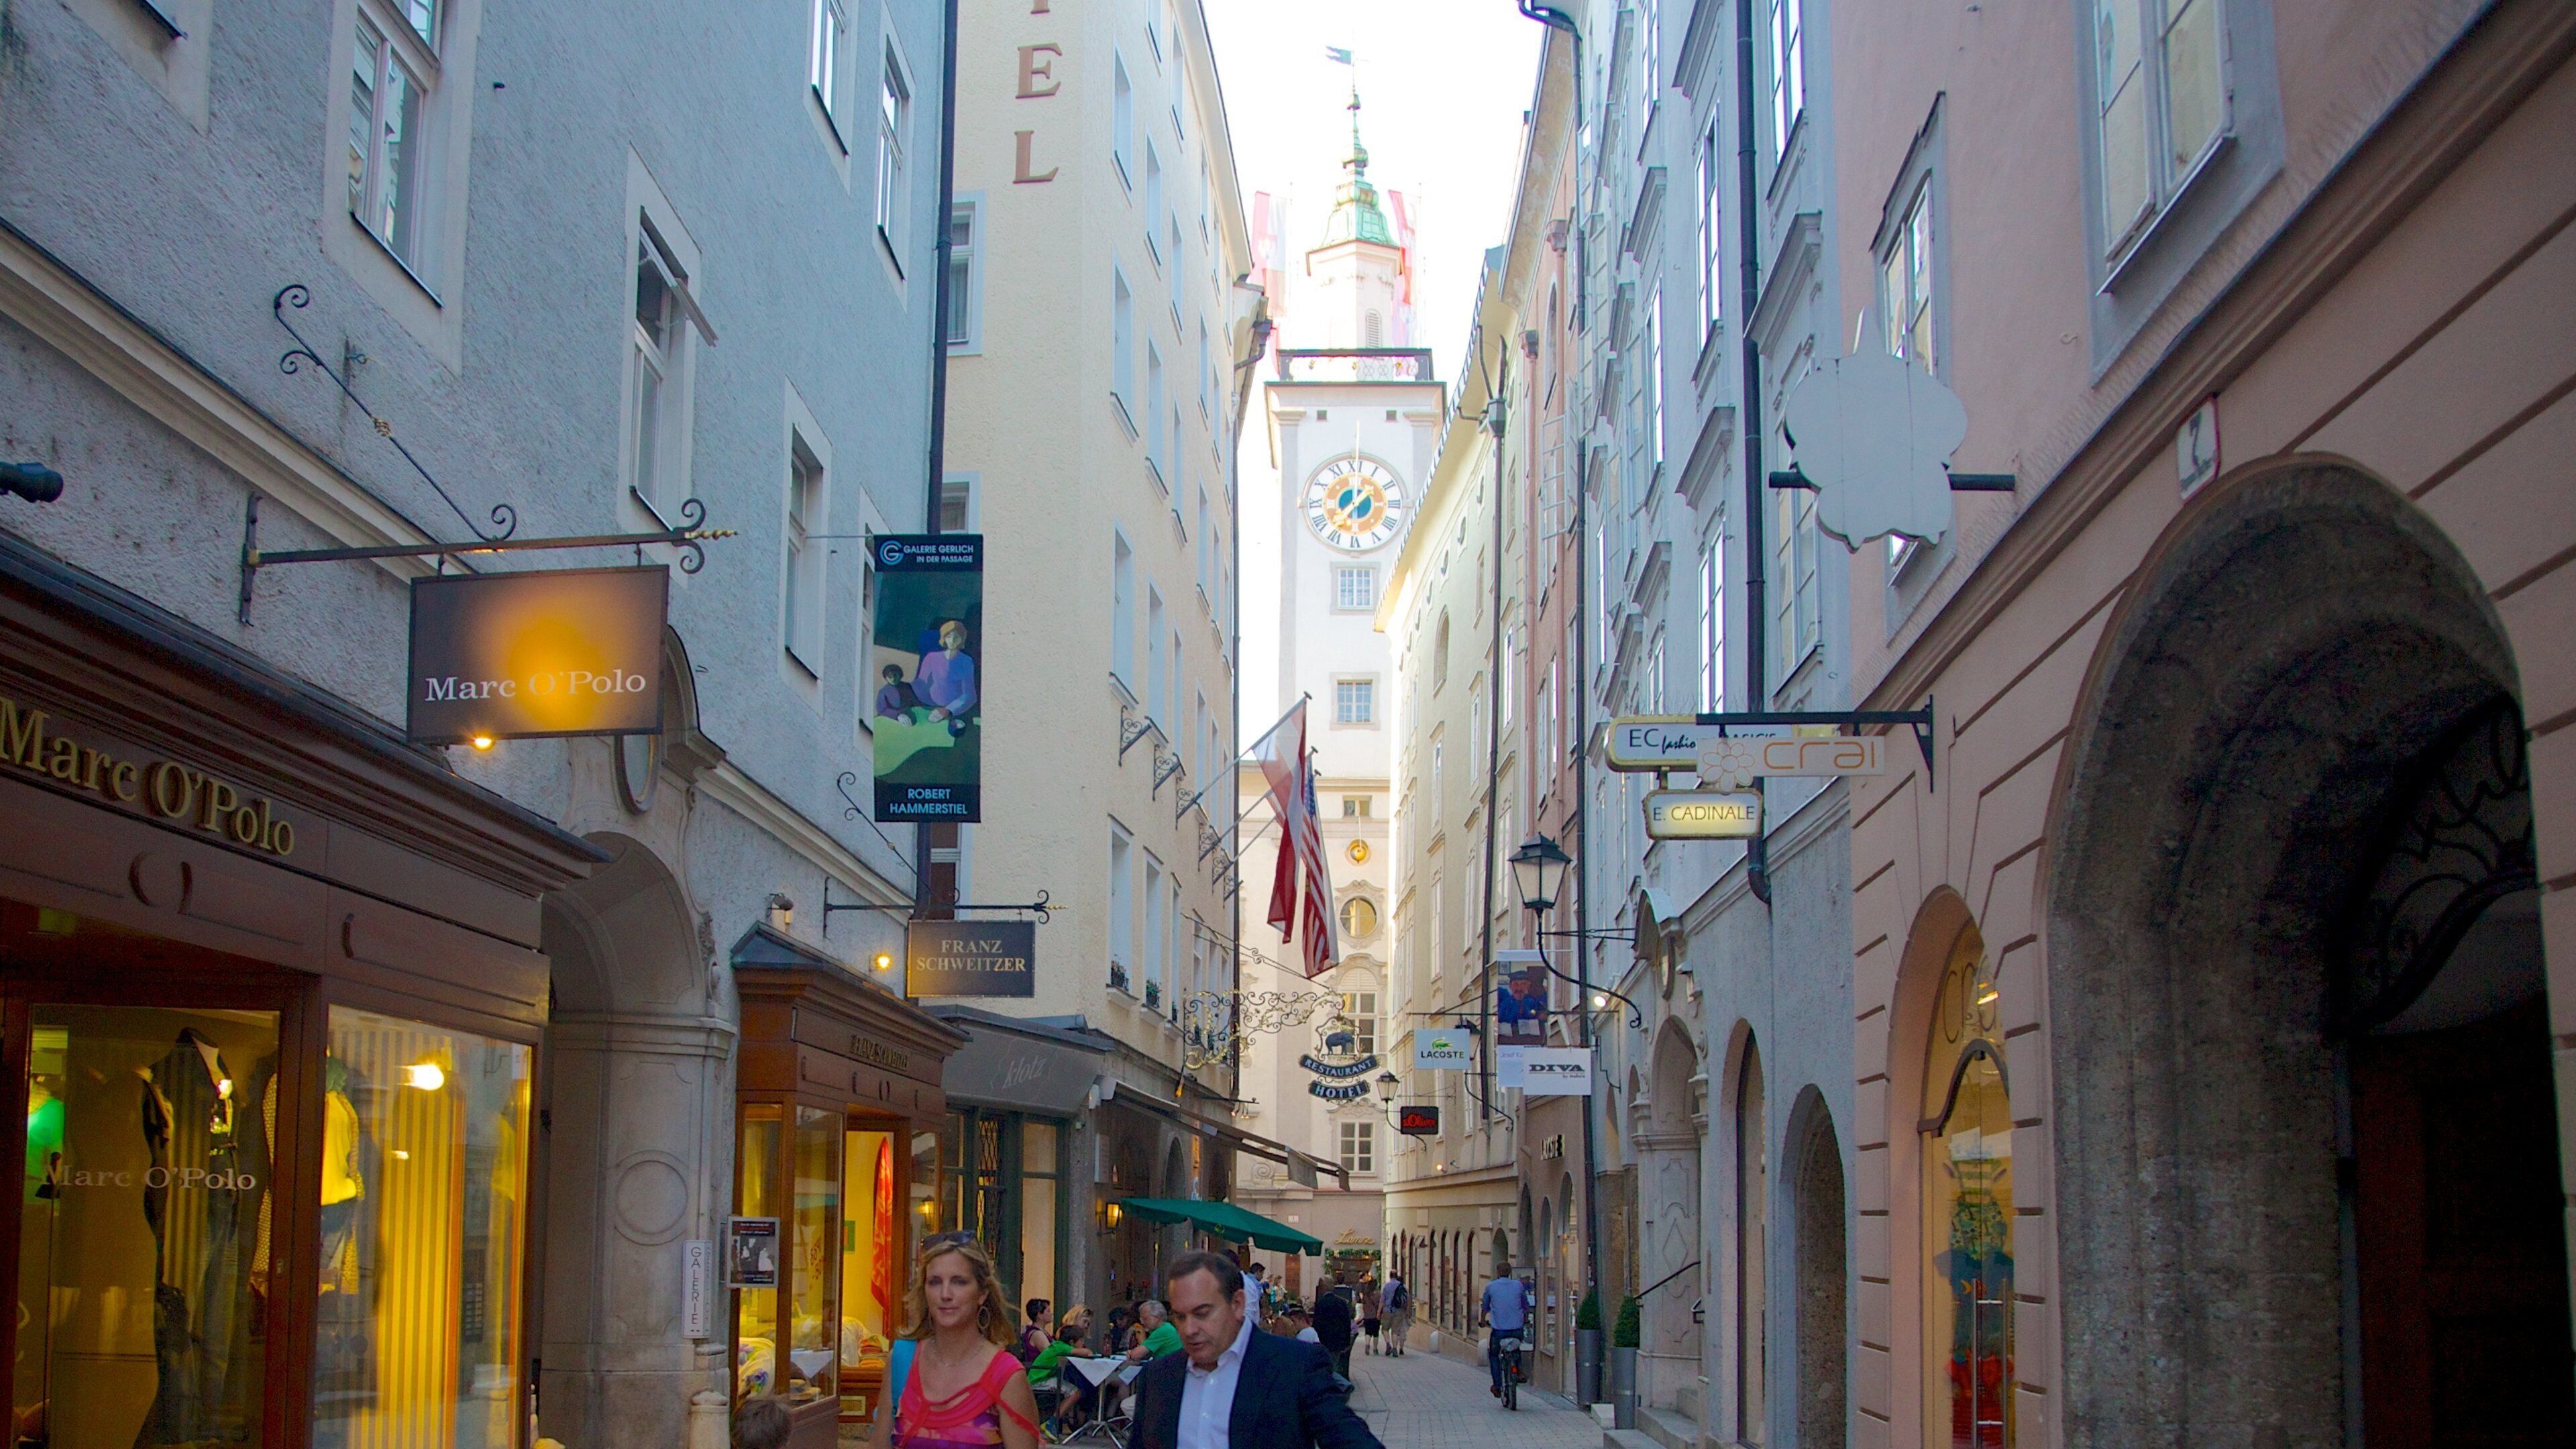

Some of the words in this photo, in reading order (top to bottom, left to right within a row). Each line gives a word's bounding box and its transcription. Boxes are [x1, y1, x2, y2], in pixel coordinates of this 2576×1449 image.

[1012, 0, 1062, 184] EL
[903, 545, 936, 553] GALERIE
[938, 545, 973, 553] GERLICH
[425, 676, 516, 701] Marc
[529, 669, 646, 696] O'Polo
[1662, 734, 1697, 755] fashio
[0, 696, 138, 802] Marc
[155, 760, 295, 856] O'Polo
[908, 788, 951, 799] ROBERT
[890, 803, 968, 814] HAMMERSTIEL
[1653, 807, 1666, 821] E.
[1671, 806, 1755, 820] CADINALE
[941, 940, 1003, 953] FRANZ
[917, 957, 1026, 971] SCHWEITZER
[1421, 1051, 1464, 1059] LACOSTE
[1305, 1058, 1373, 1076] RESTAURANT
[1529, 1064, 1585, 1072] DIVA
[1316, 1085, 1364, 1098] HOTEL
[43, 1165, 131, 1187] Marc
[144, 1167, 256, 1190] O'Polo
[690, 1246, 702, 1325] GALERIE
